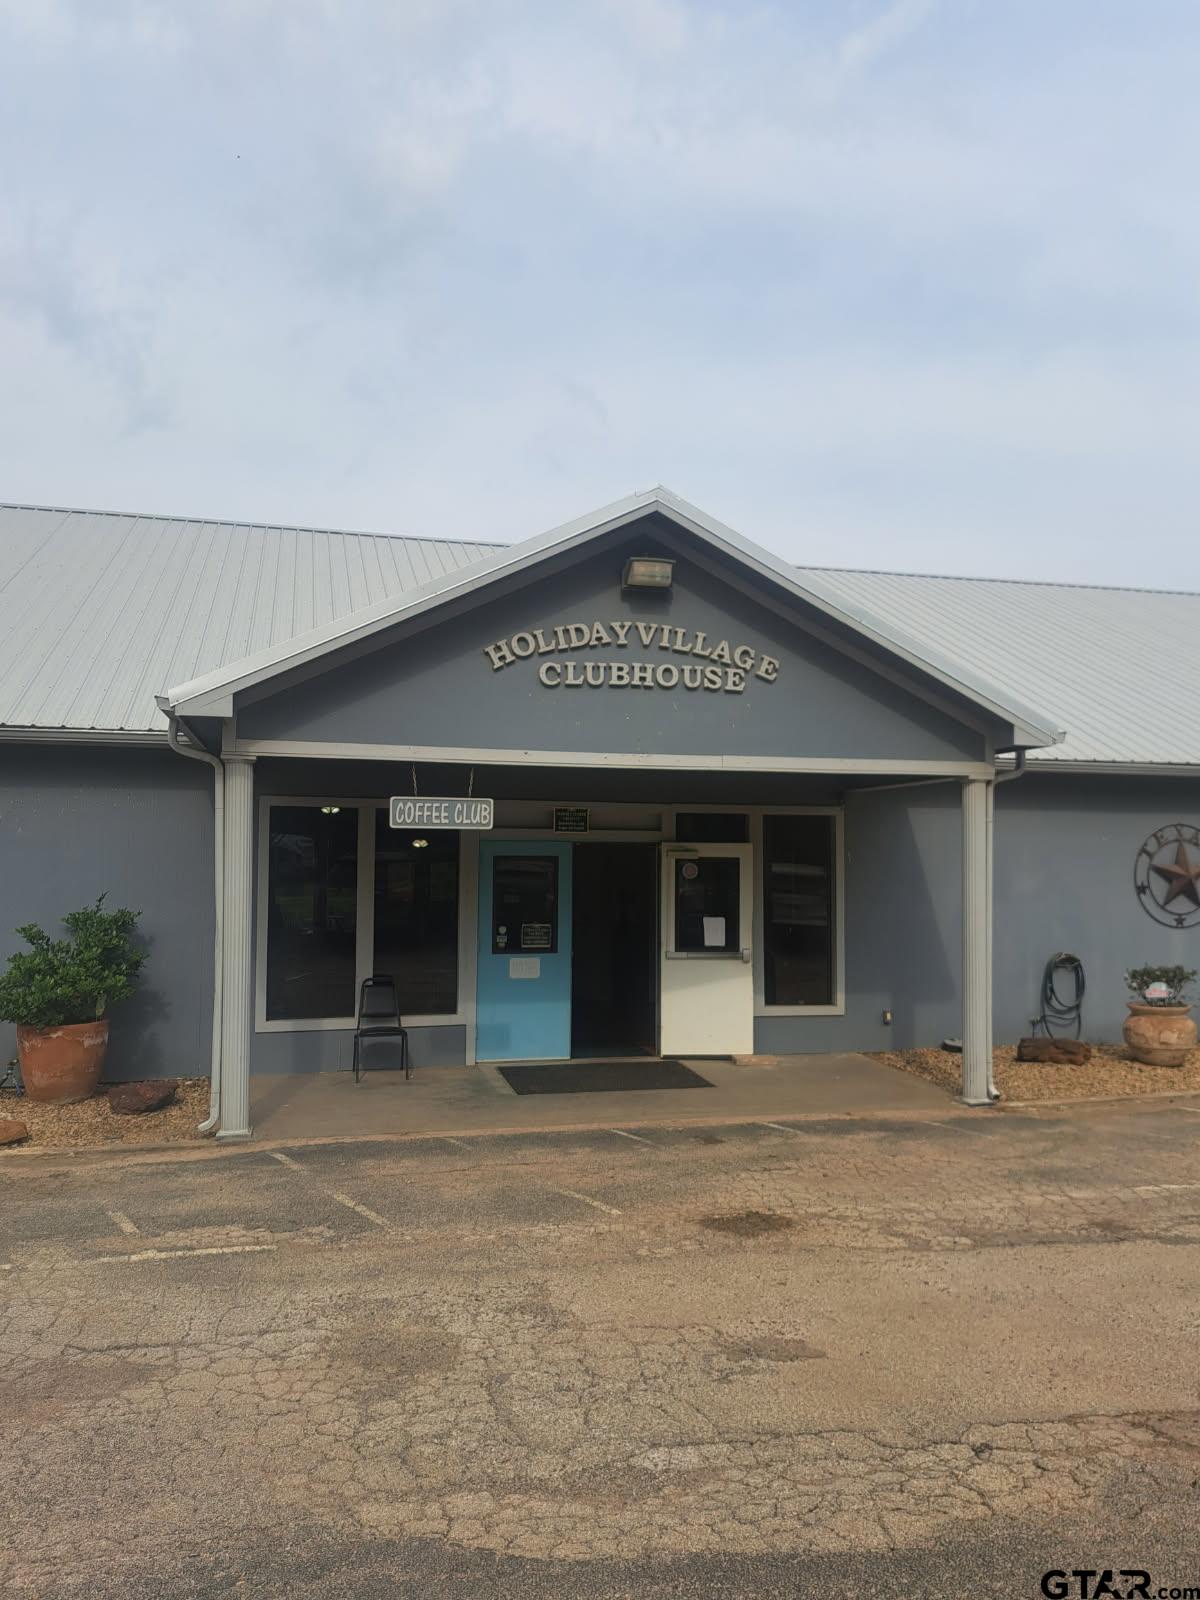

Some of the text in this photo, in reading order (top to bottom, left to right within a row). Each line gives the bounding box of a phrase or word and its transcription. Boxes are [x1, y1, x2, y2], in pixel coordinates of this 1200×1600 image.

[539, 661, 747, 692] CLUBHOUSE
[395, 802, 490, 825] COFFEE CLUB
